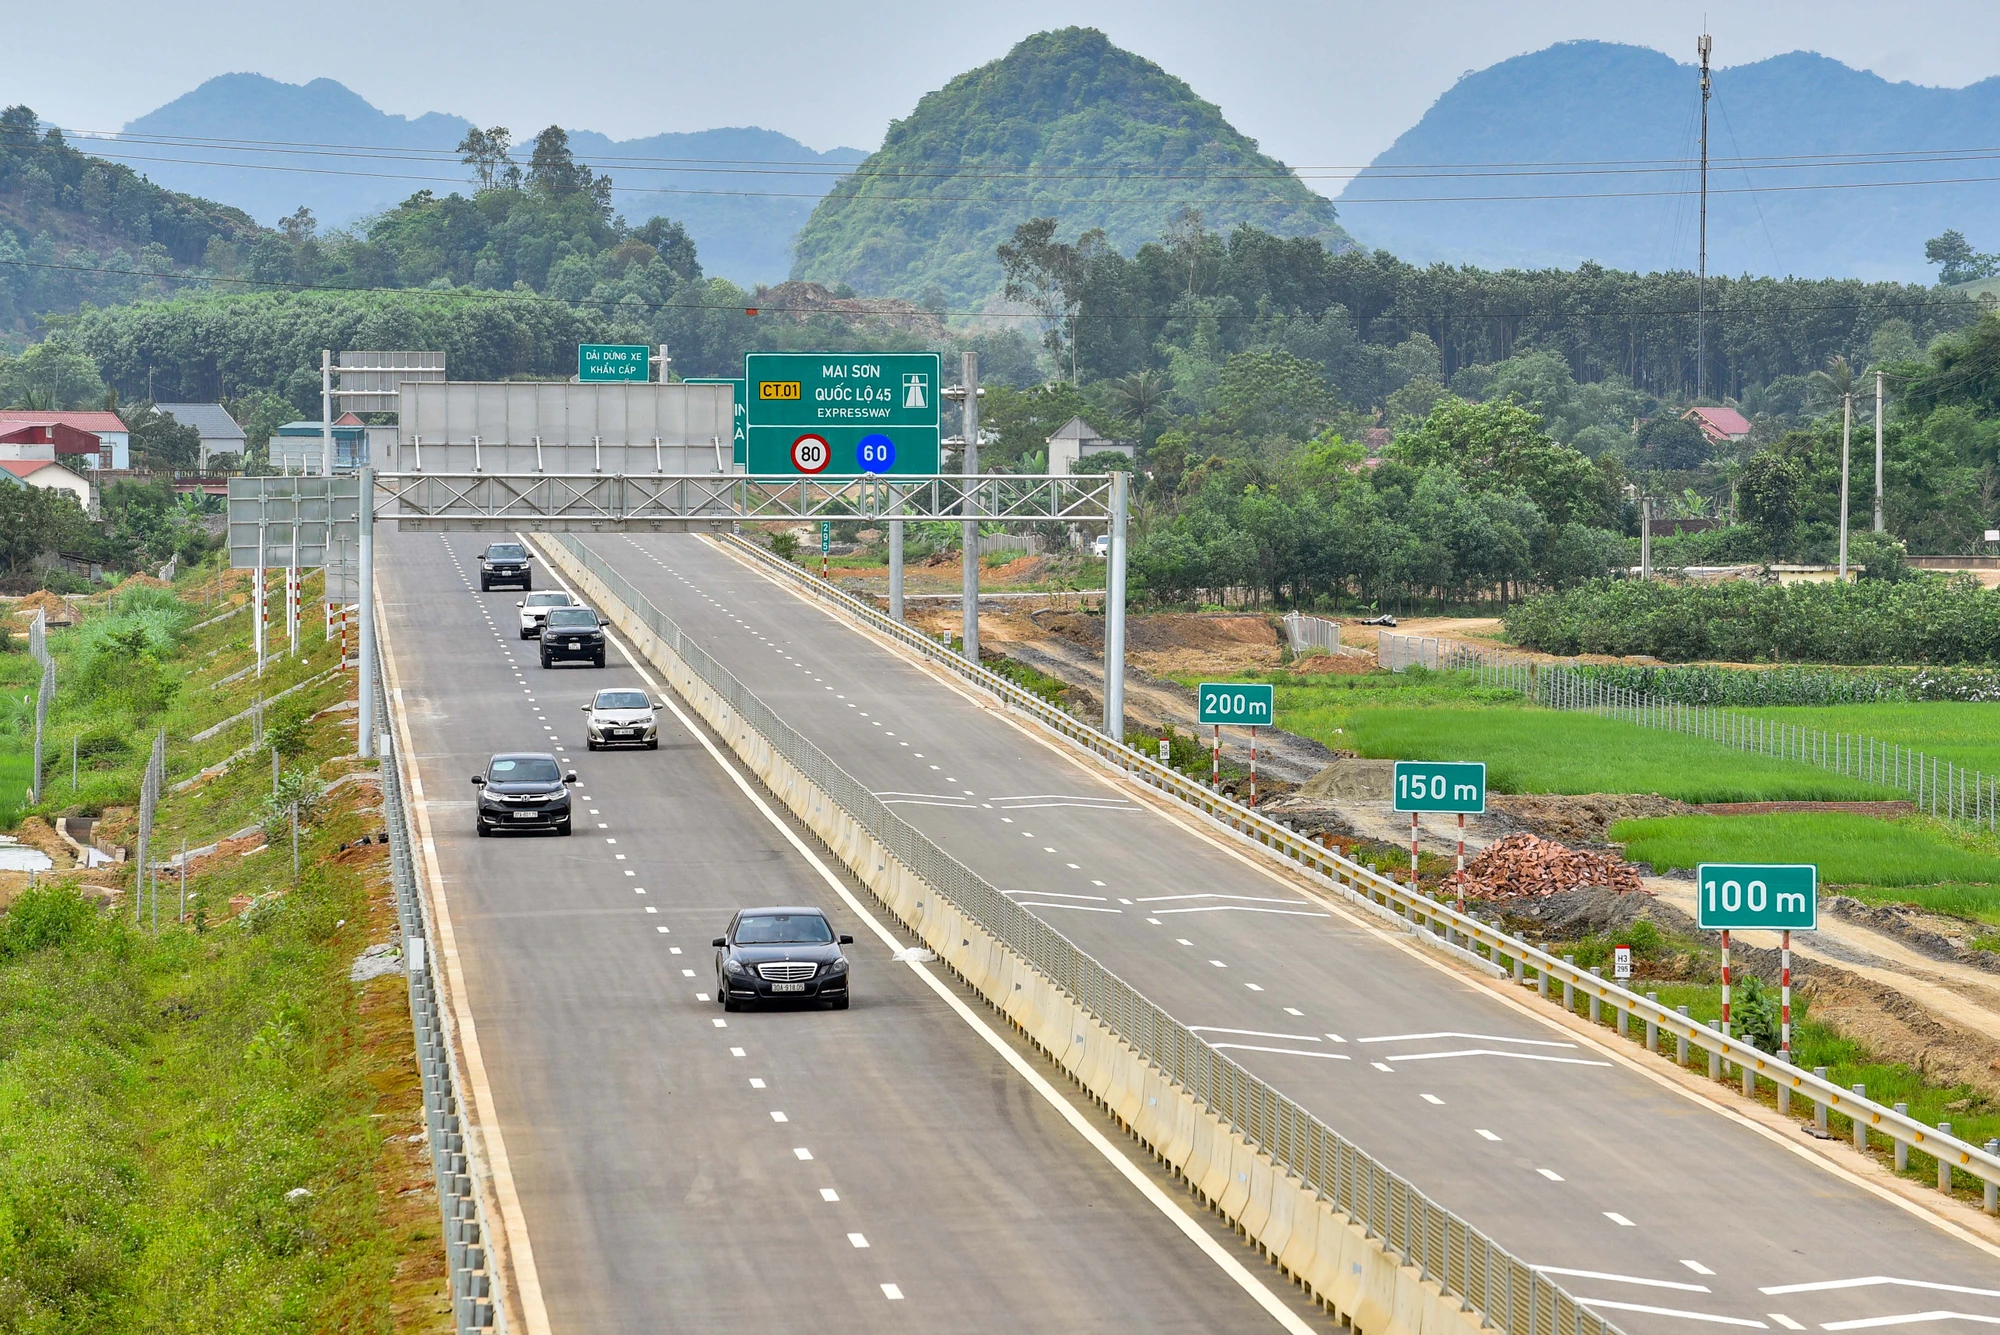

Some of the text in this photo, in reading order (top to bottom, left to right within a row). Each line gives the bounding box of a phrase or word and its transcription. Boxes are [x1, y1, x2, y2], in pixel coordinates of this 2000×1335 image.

[586, 349, 642, 361] DẢI DỪNG XE
[590, 362, 637, 375] KHẨN CẤP
[822, 363, 881, 378] MAI SƠN
[763, 384, 798, 397] CT.01
[815, 383, 892, 404] QUỐC LỘ 45
[817, 407, 891, 418] EXPRESSWAY
[801, 446, 821, 462] 80
[863, 445, 887, 462] 60
[1205, 693, 1267, 716] 200 m
[1398, 774, 1478, 801] 150 m
[1704, 880, 1806, 913] 100 m
[1617, 954, 1628, 963] H3
[1617, 965, 1628, 973] 295
